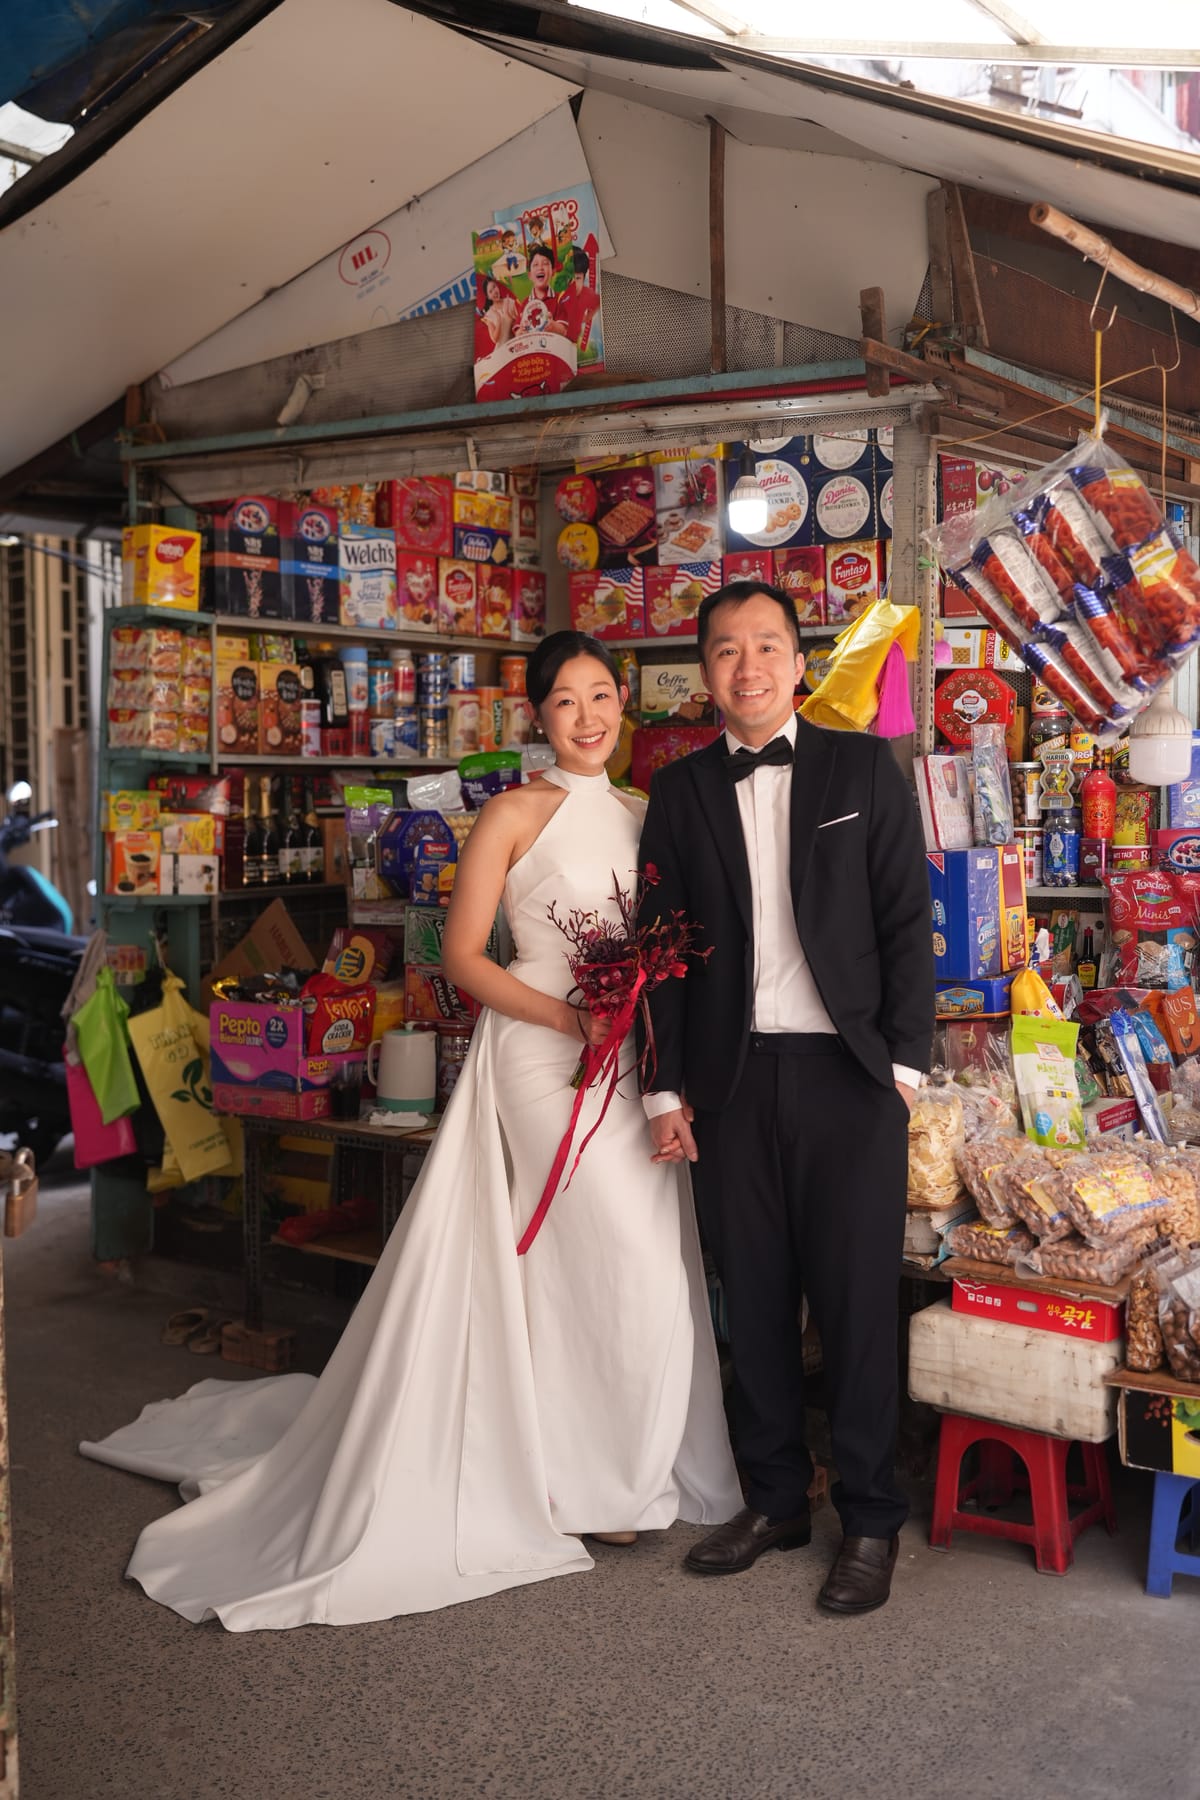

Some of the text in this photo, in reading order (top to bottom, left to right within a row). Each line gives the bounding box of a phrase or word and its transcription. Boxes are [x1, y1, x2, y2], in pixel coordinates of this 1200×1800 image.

[759, 472, 789, 488] anisa
[824, 485, 858, 505] Danisa
[344, 543, 394, 565] Welch's
[834, 563, 869, 580] Fantasy
[986, 632, 996, 665] CRACKERS
[657, 672, 688, 687] Coffee
[670, 685, 690, 699] Joy
[1132, 879, 1172, 892] Loacker
[934, 900, 943, 926] OREO
[1134, 905, 1171, 920] Minis
[978, 928, 996, 944] OREO
[336, 948, 361, 982] RITZ
[433, 978, 450, 1017] CRACKERS
[219, 1013, 261, 1037] Pepto
[269, 1018, 284, 1033] 2X
[1060, 1304, 1097, 1329] 곶감
